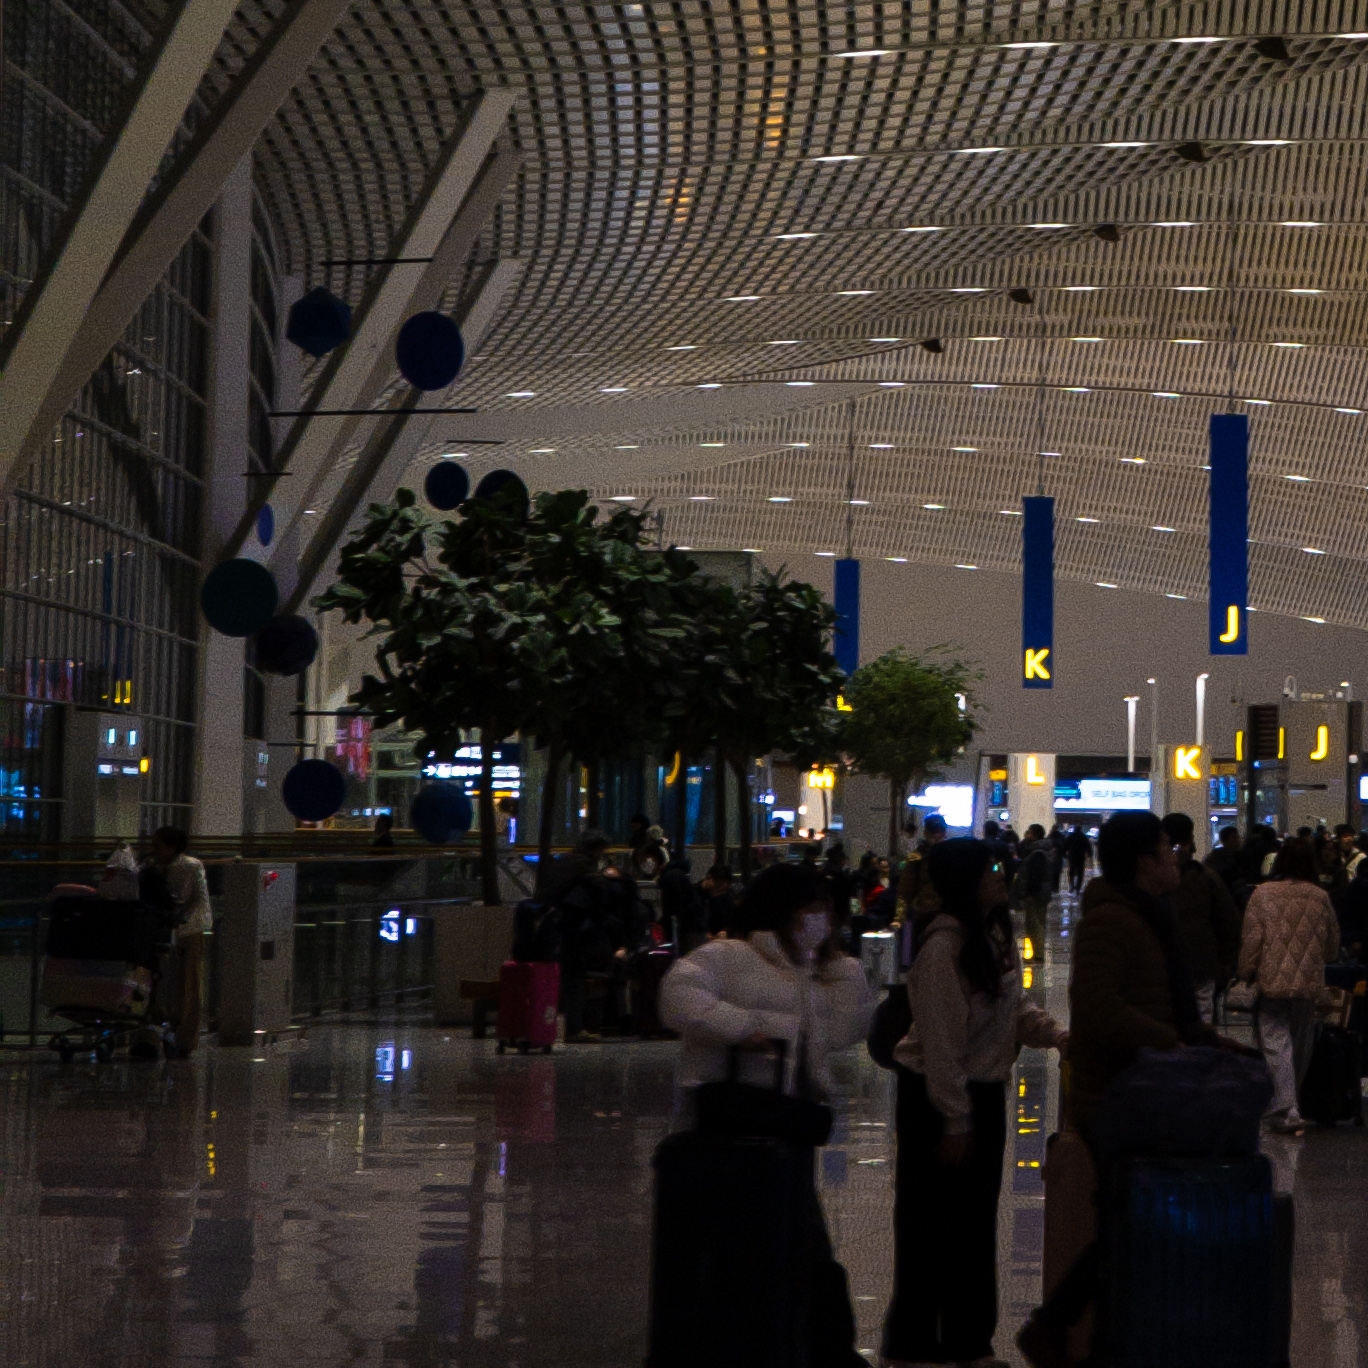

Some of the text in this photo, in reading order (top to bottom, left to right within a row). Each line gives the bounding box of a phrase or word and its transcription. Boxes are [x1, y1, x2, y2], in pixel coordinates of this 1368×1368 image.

[1219, 605, 1239, 643] J
[1024, 648, 1051, 680] K
[1310, 724, 1330, 762] J
[1026, 756, 1047, 786] L
[1173, 746, 1202, 780] K
